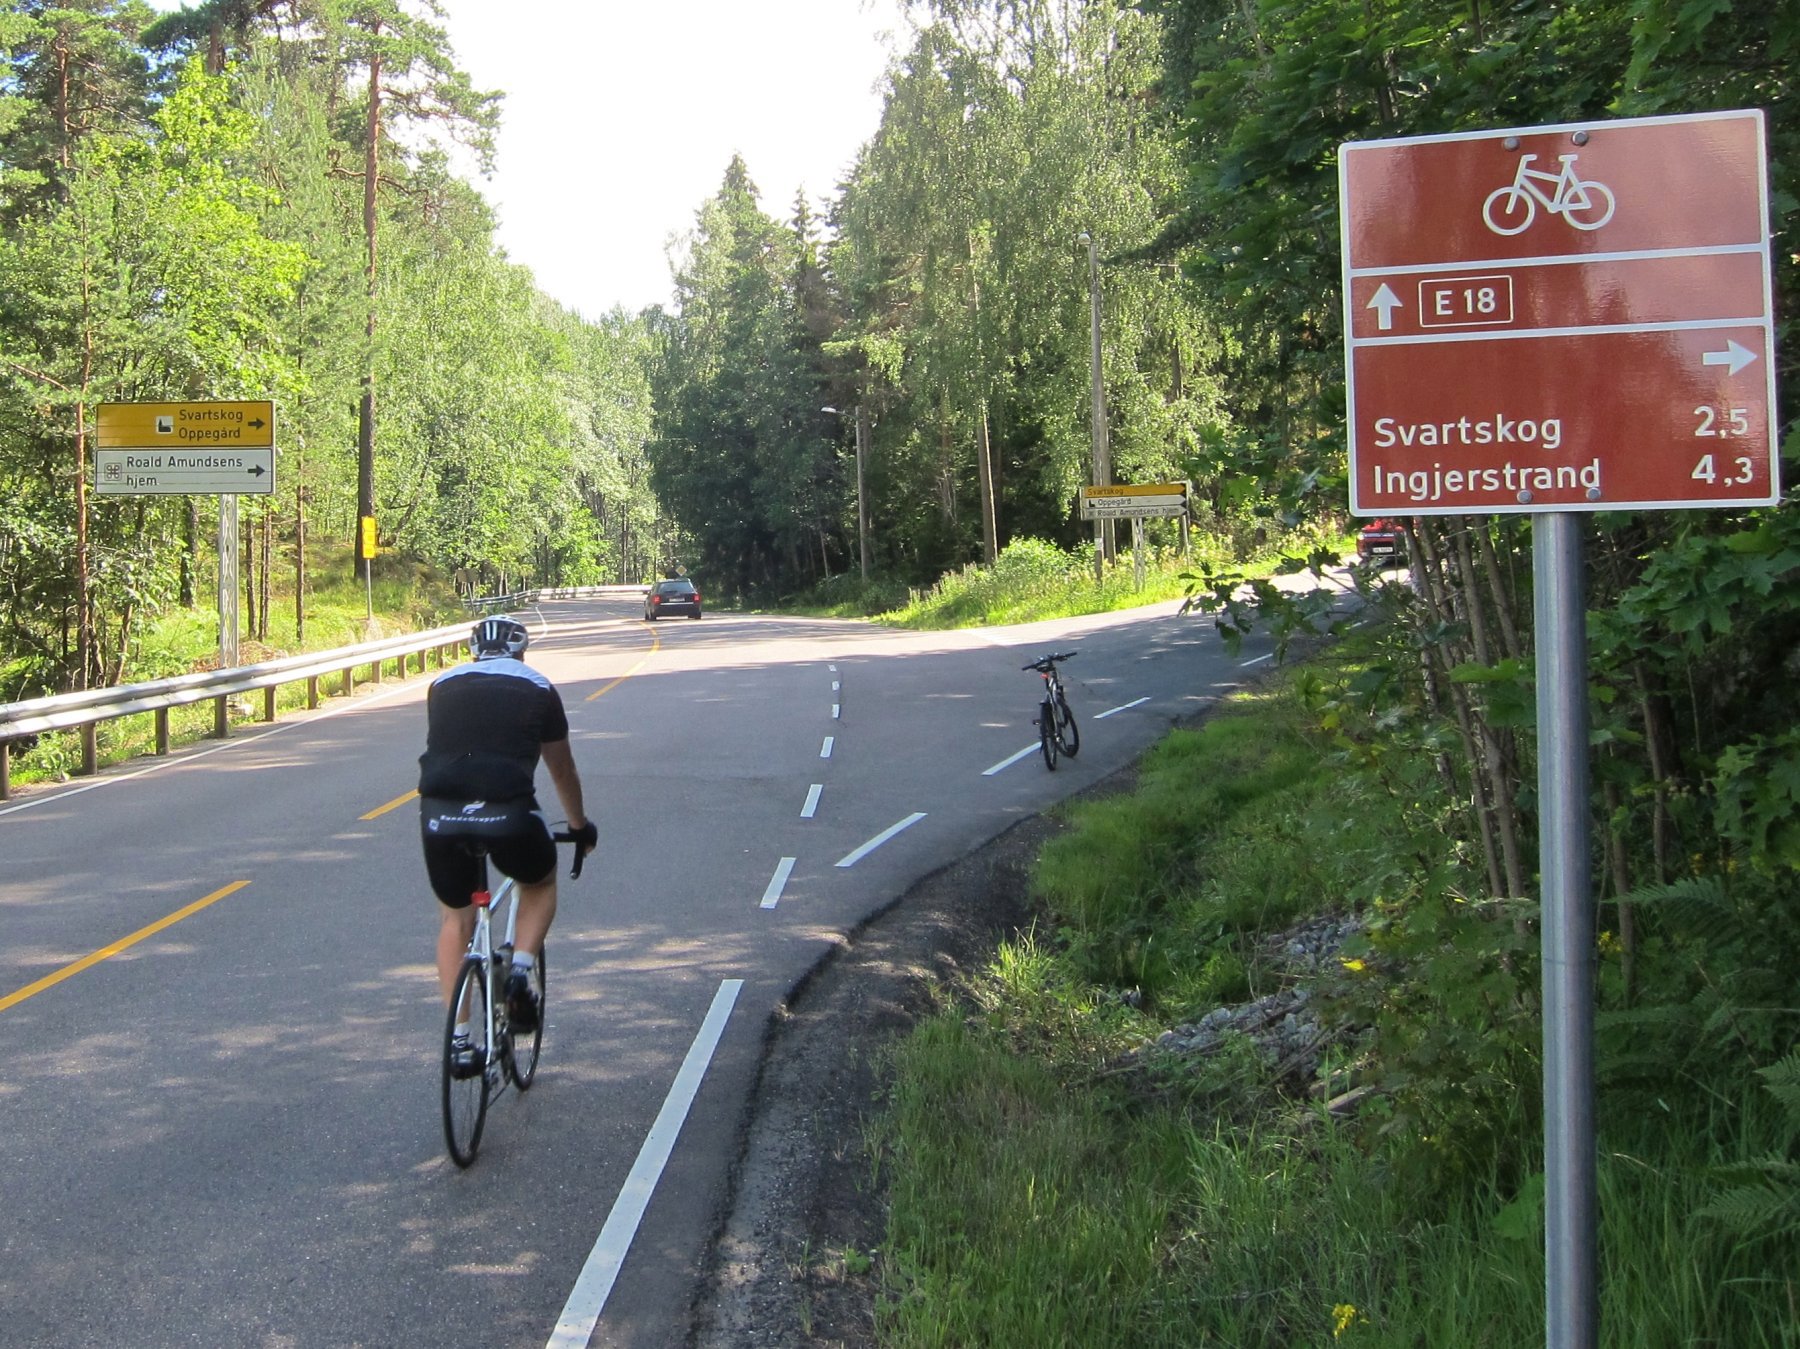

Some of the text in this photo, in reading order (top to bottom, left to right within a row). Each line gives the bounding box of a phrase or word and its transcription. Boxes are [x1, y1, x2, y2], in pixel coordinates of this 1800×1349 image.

[1435, 288, 1496, 316] E 18
[179, 409, 243, 423] Svartskog
[179, 427, 241, 441] Oppegård
[1373, 406, 1749, 449] Svartskog 2,5
[127, 456, 242, 467] Roald Amundsens
[126, 474, 157, 489] hjem
[1373, 454, 1753, 500] Ingjerstrand 4,3
[1087, 488, 1124, 496] Svartskog
[1097, 509, 1116, 517] Roald
[1120, 508, 1159, 516] Amundsens
